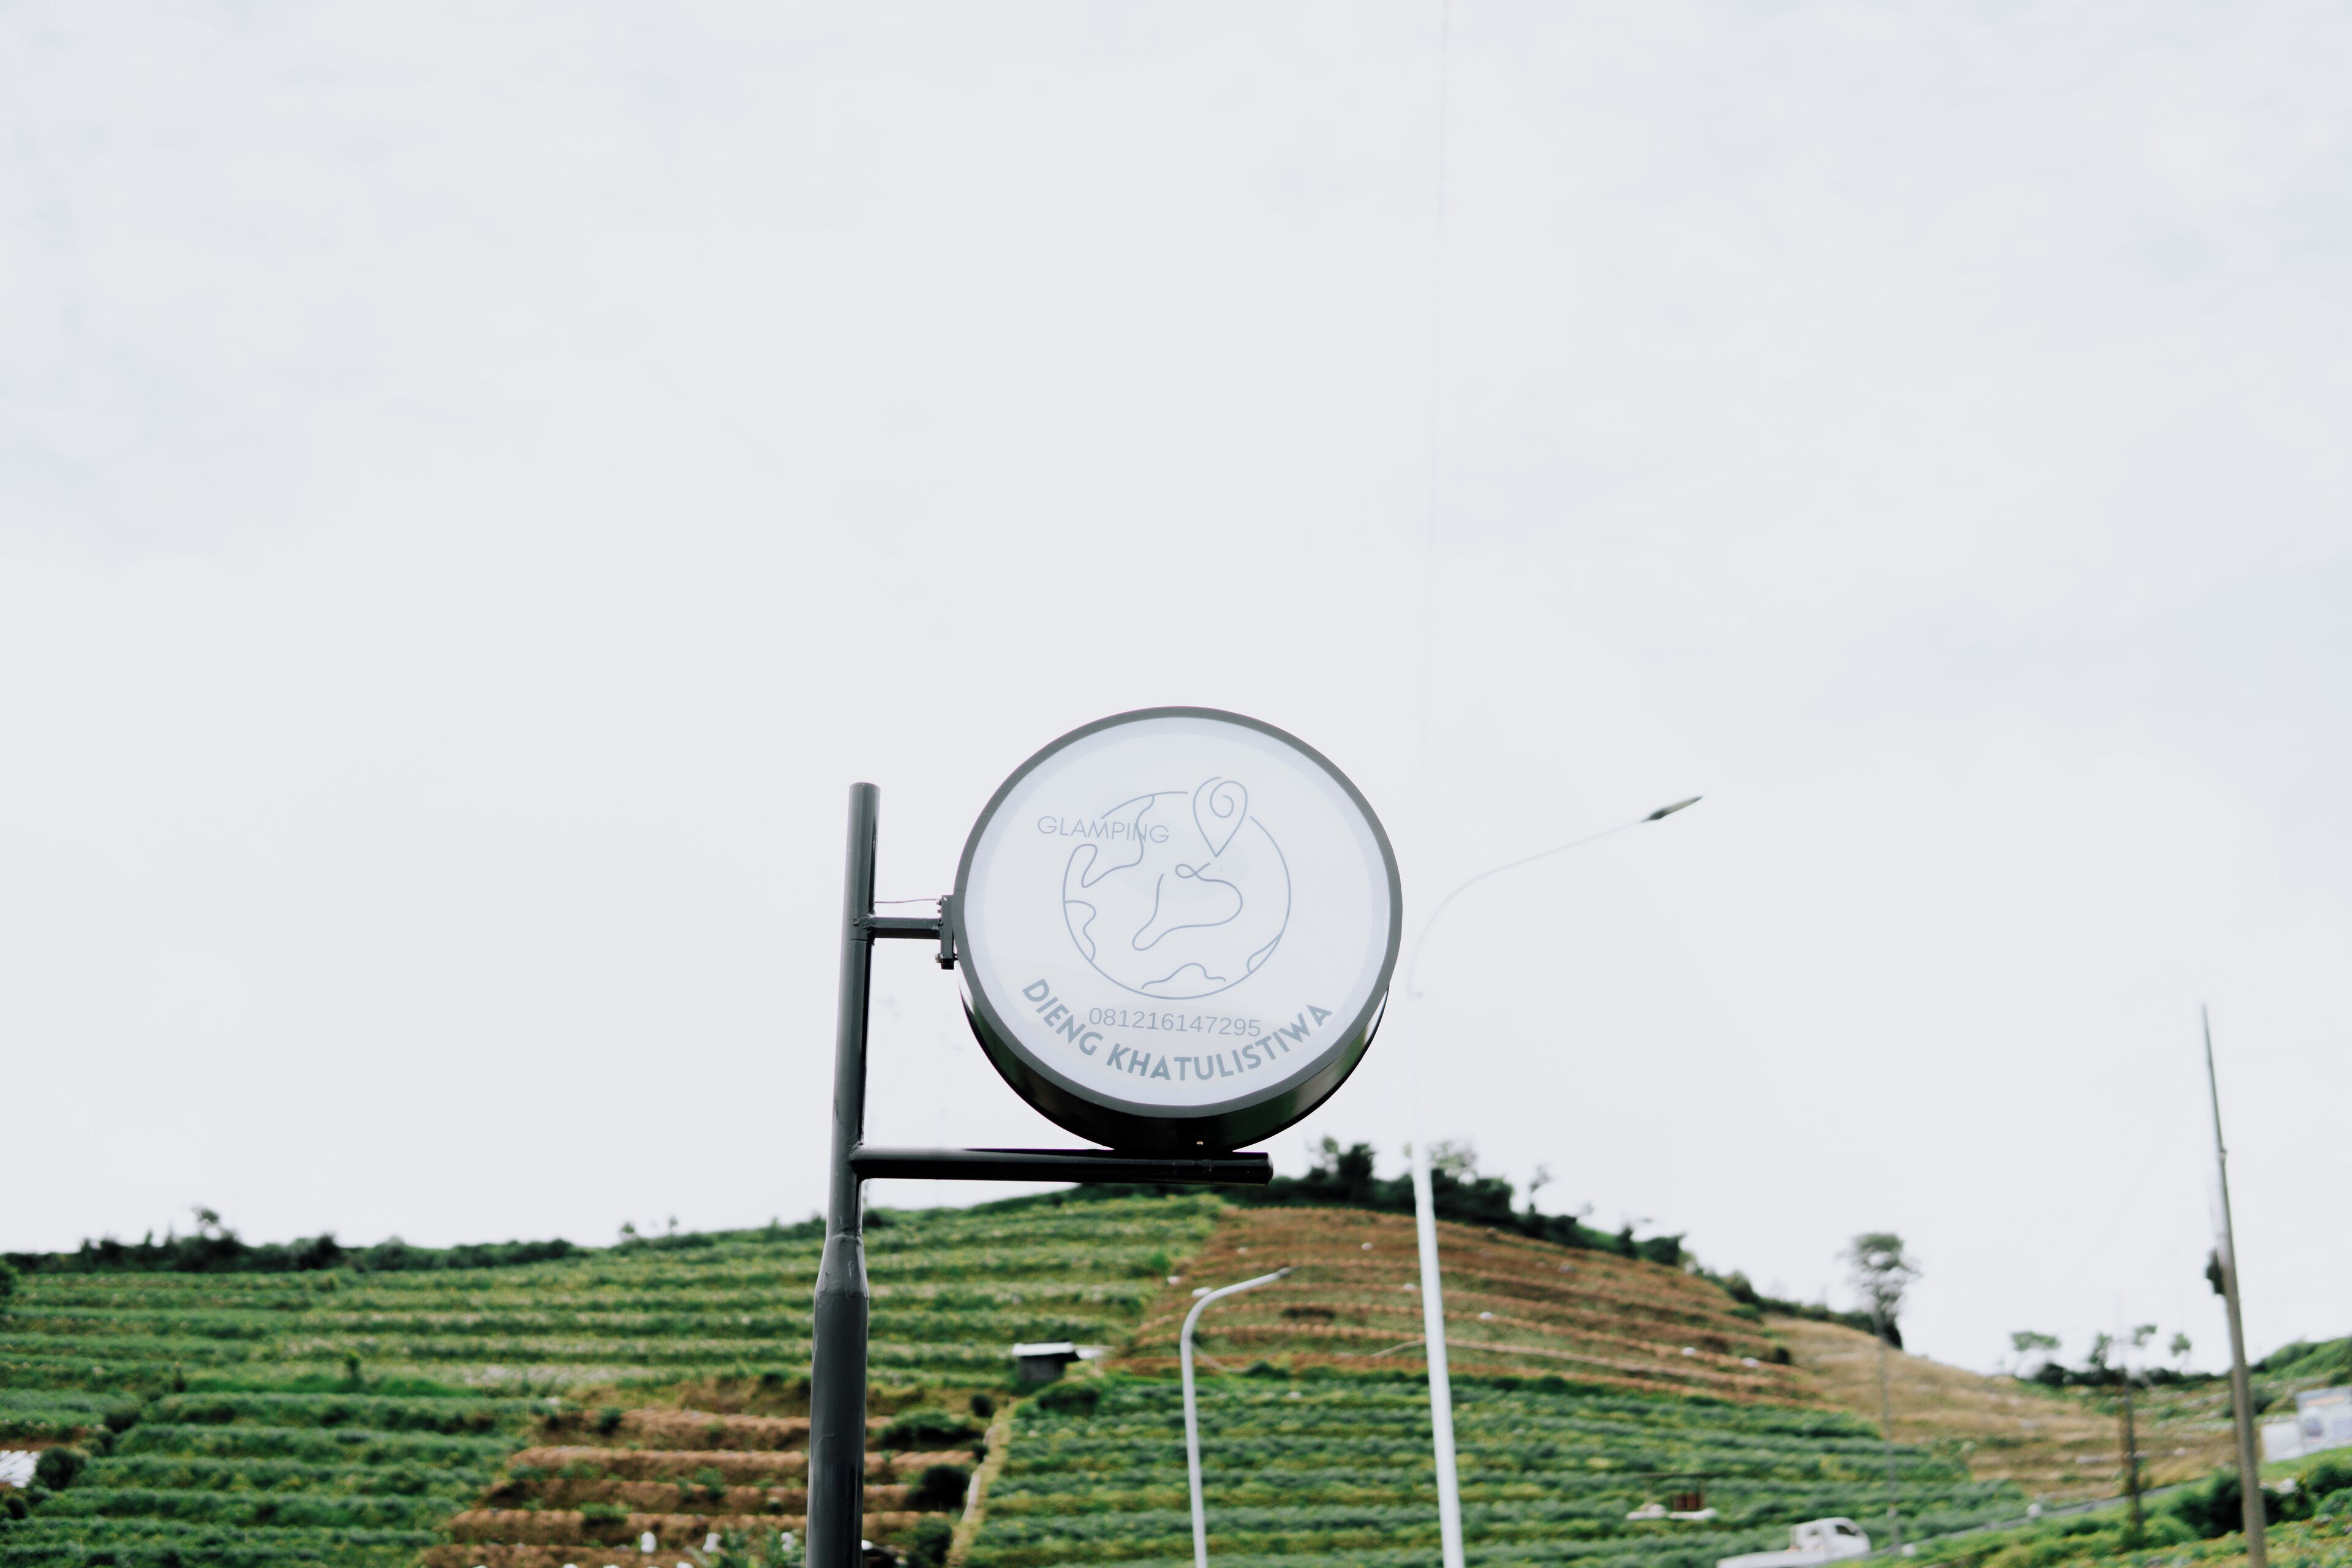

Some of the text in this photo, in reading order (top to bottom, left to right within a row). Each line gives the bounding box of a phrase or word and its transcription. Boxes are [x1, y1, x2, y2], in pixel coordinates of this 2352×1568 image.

[1038, 816, 1169, 843] GLAMPING
[1022, 978, 1333, 1081] DIENG KHATULISTIWA
[1088, 1008, 1261, 1037] 081216147295
